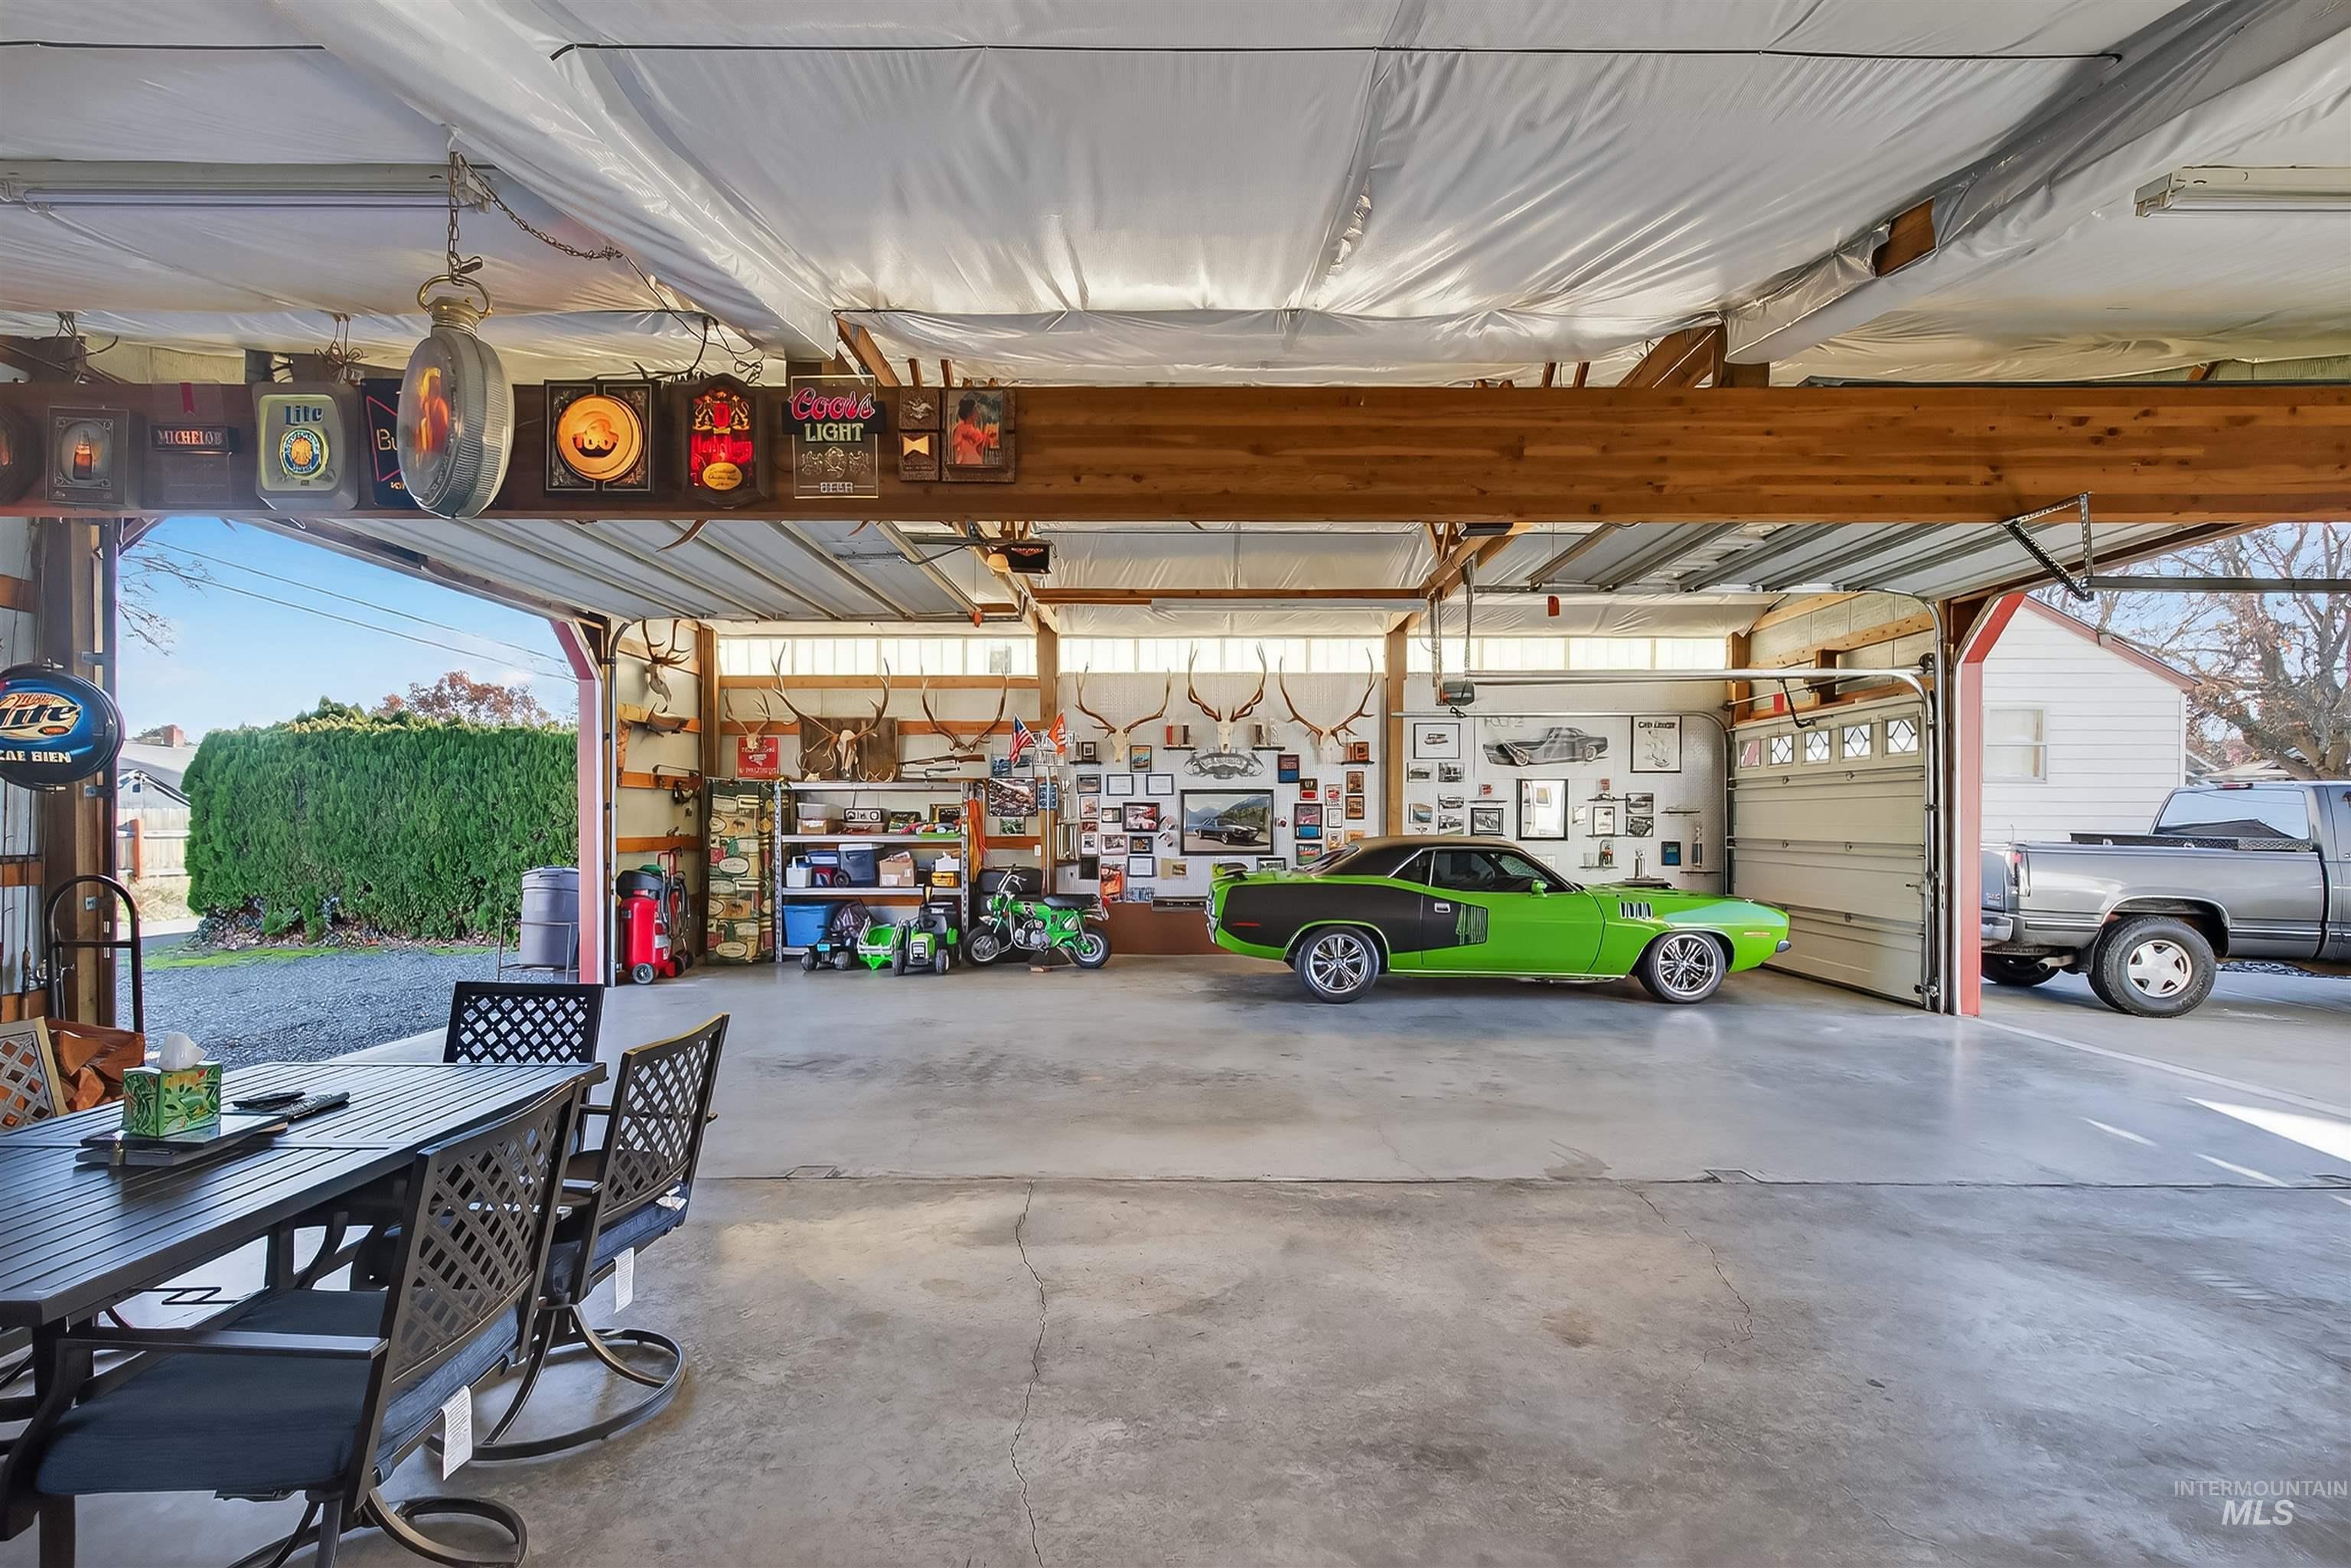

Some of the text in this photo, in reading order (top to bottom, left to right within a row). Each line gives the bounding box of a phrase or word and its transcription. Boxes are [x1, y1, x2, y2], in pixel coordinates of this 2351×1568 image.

[285, 405, 323, 426] Lite
[158, 429, 222, 445] MICHELOB
[804, 422, 864, 442] LIGHT
[31, 751, 72, 763] BIEN
